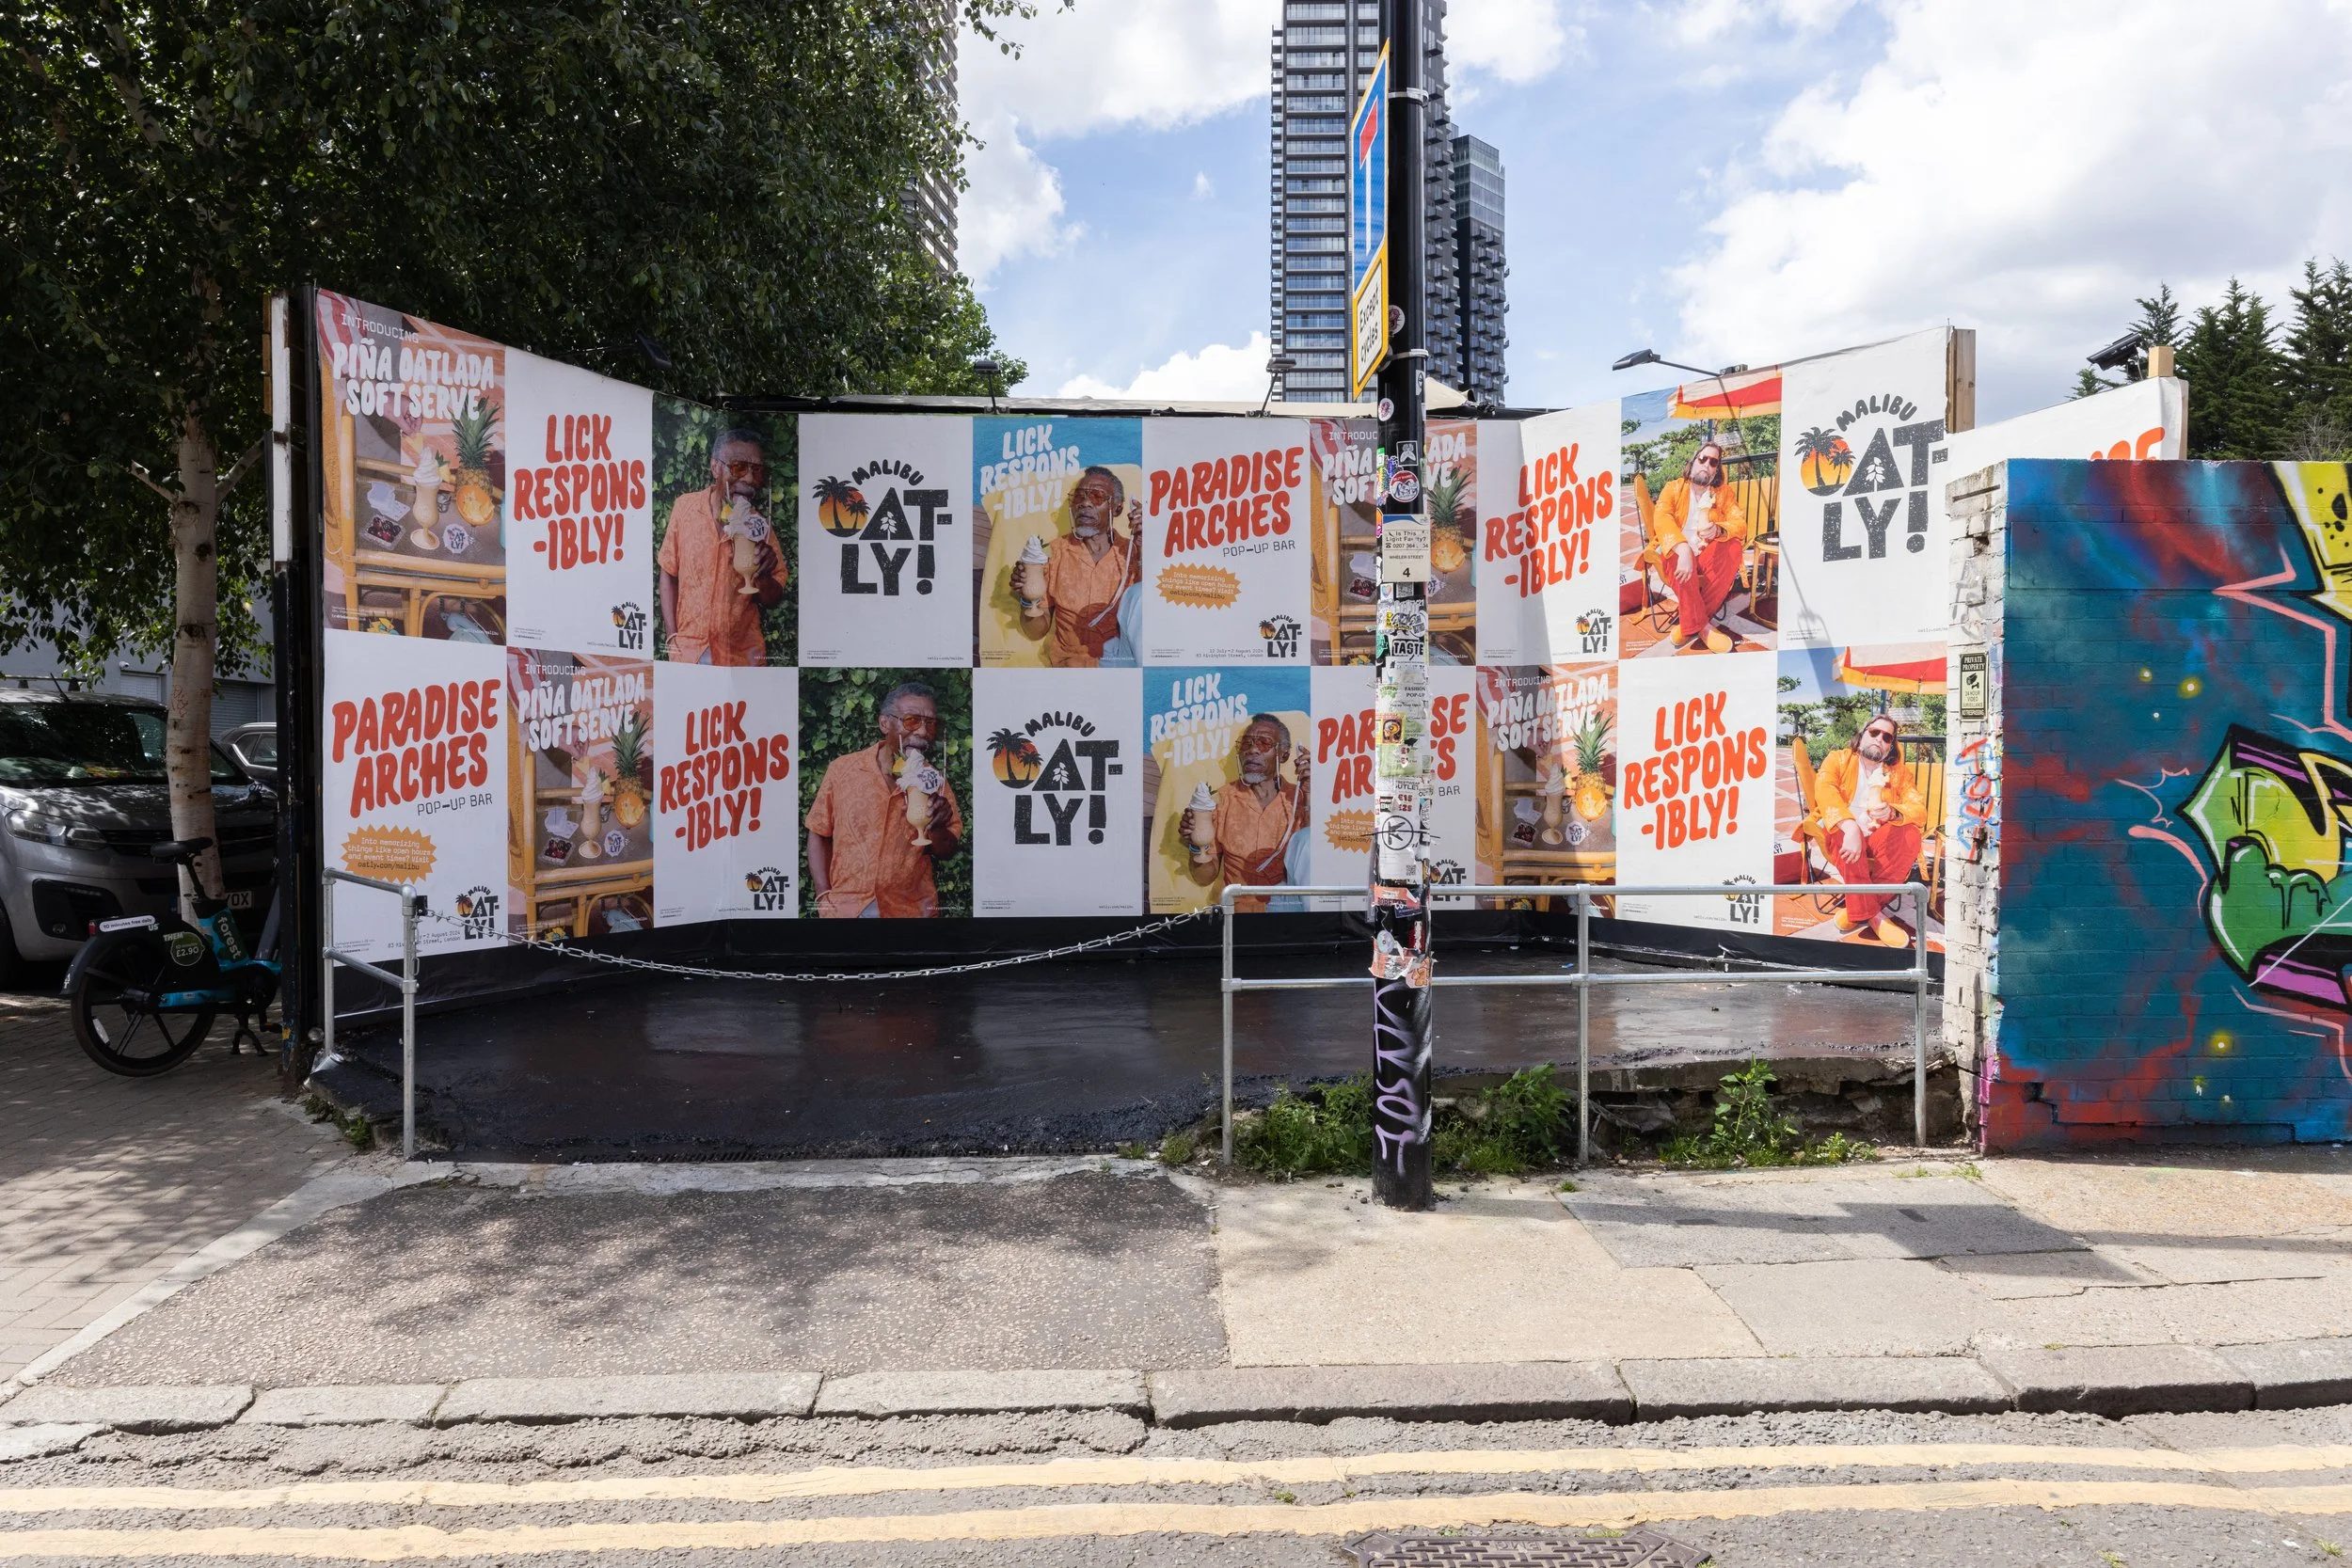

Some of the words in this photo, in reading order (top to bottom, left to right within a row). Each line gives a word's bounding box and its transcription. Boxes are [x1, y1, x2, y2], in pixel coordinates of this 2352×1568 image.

[1359, 283, 1378, 332] Except
[341, 313, 420, 344] INTRODUCING
[1360, 322, 1378, 363] cycles
[332, 338, 392, 381] PIÑA
[399, 347, 495, 390] OATLADA
[346, 379, 405, 417] SOFT
[409, 385, 481, 420] SERVE
[1837, 393, 1917, 432] MALIBU
[546, 414, 612, 463] LICK
[1002, 423, 1053, 460] LICK
[851, 459, 924, 485] MALIBU
[979, 446, 1080, 495] RESPONS
[1150, 447, 1305, 516] PARADISE
[1322, 445, 1373, 482] PIÑA
[1519, 443, 1579, 510] LICK
[514, 460, 645, 521] RESPONS
[993, 485, 1063, 520] -IBLY!
[1164, 492, 1292, 558] ARCHES
[1485, 471, 1613, 562] RESPONS
[1823, 489, 1929, 562] LY!
[532, 515, 625, 570] -IBLY!
[1222, 543, 1269, 558] POP-UP
[1273, 539, 1296, 553] BAR
[841, 542, 936, 596] LY!
[1162, 577, 1184, 586] things
[1189, 574, 1226, 582] memorizing
[1403, 567, 1410, 578] 4
[1504, 529, 1590, 598] -IBLY!
[621, 602, 641, 611] MALIBU
[1169, 590, 1226, 600] oatly.com/malibu
[1585, 608, 1605, 617] MALIBU
[1270, 614, 1294, 623] MALIBU
[618, 630, 644, 650] LY!
[1267, 641, 1296, 657] LY!
[1393, 641, 1424, 656] TASTE
[1582, 636, 1608, 653] LY!
[525, 664, 586, 675] INTRODUCING
[1494, 675, 1550, 688] INTRODUCING
[517, 680, 565, 723] PIÑA
[570, 673, 645, 712] OATLADA
[1171, 673, 1222, 709] LICK
[1486, 690, 1534, 728] PIÑA
[1536, 673, 1609, 716] OATLADA
[332, 679, 501, 763] PARADISE
[528, 714, 576, 752] SOFT
[579, 705, 634, 742] SERVE
[686, 701, 747, 757] LICK
[1024, 710, 1096, 737] MALIBU
[1151, 693, 1248, 744] RESPONS
[1318, 693, 1470, 764] PARSE
[1497, 717, 1540, 752] SOFT
[1543, 705, 1597, 742] SERVE
[1654, 690, 1727, 752] LICK
[1163, 735, 1232, 768] -IBLY!
[1623, 726, 1768, 809] RESPONS
[350, 732, 488, 818] ARCHES
[660, 734, 789, 815] RESPONS
[1438, 785, 1460, 796] BAR
[417, 798, 465, 816] POP-UP
[470, 792, 492, 809] BAR
[675, 787, 762, 852] -IBLY!
[1014, 794, 1106, 846] LY!
[1641, 786, 1740, 850] -IBLY!
[348, 845, 373, 853] things
[379, 839, 420, 848] memorizing
[358, 861, 420, 871] oatly.com/malibu
[757, 866, 781, 875] MALIBU
[1436, 859, 1458, 867] MALIBU
[1734, 875, 1756, 884] MALIBU
[468, 885, 491, 895] MALIBU
[754, 894, 785, 911] LY!
[464, 917, 495, 940] LY!
[1730, 903, 1759, 924] LY!
[163, 932, 184, 941] THEM
[176, 946, 199, 958] £2.90
[218, 916, 242, 959] forest
